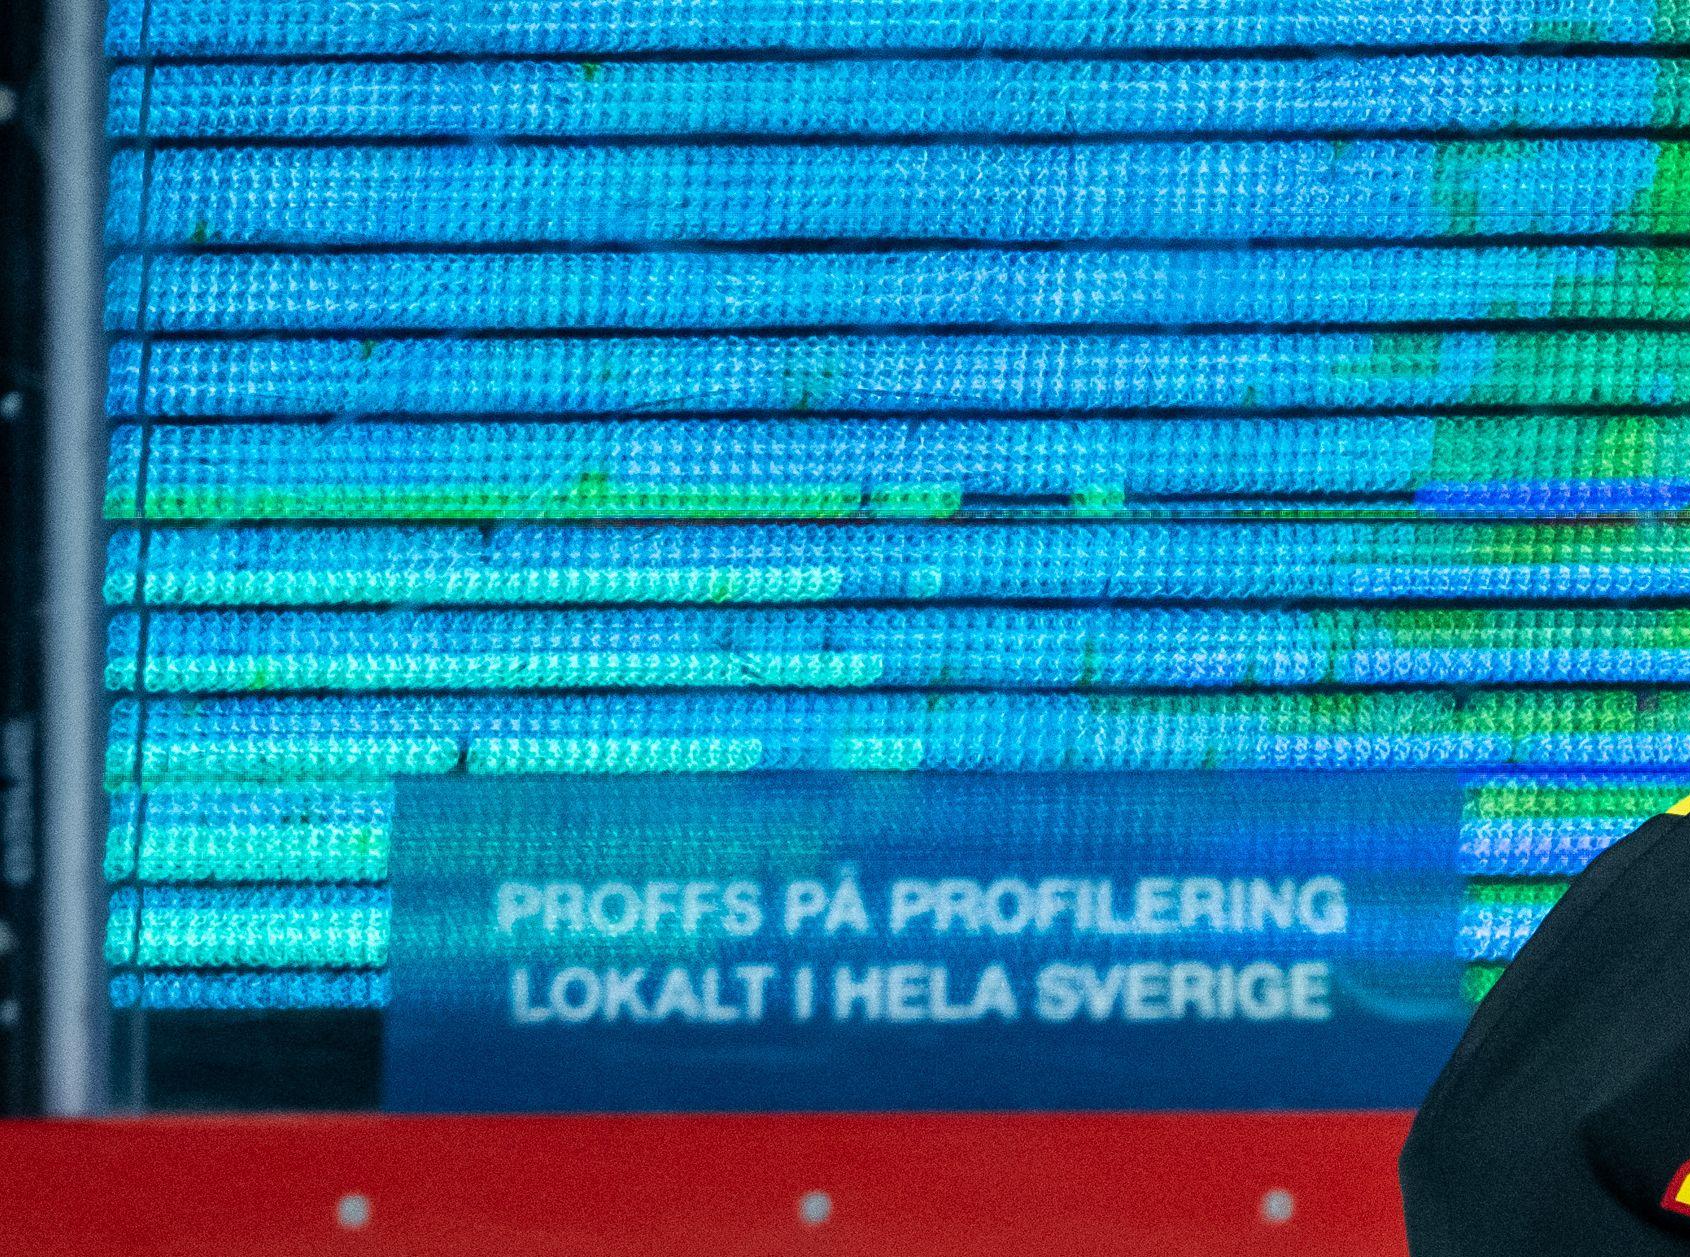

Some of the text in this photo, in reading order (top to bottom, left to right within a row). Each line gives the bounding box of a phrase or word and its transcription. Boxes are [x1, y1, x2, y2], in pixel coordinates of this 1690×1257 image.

[496, 862, 1350, 937] PROFFS PÅ PROFILERING
[511, 961, 1333, 1024] LOKALT I HELA SVERIGE
